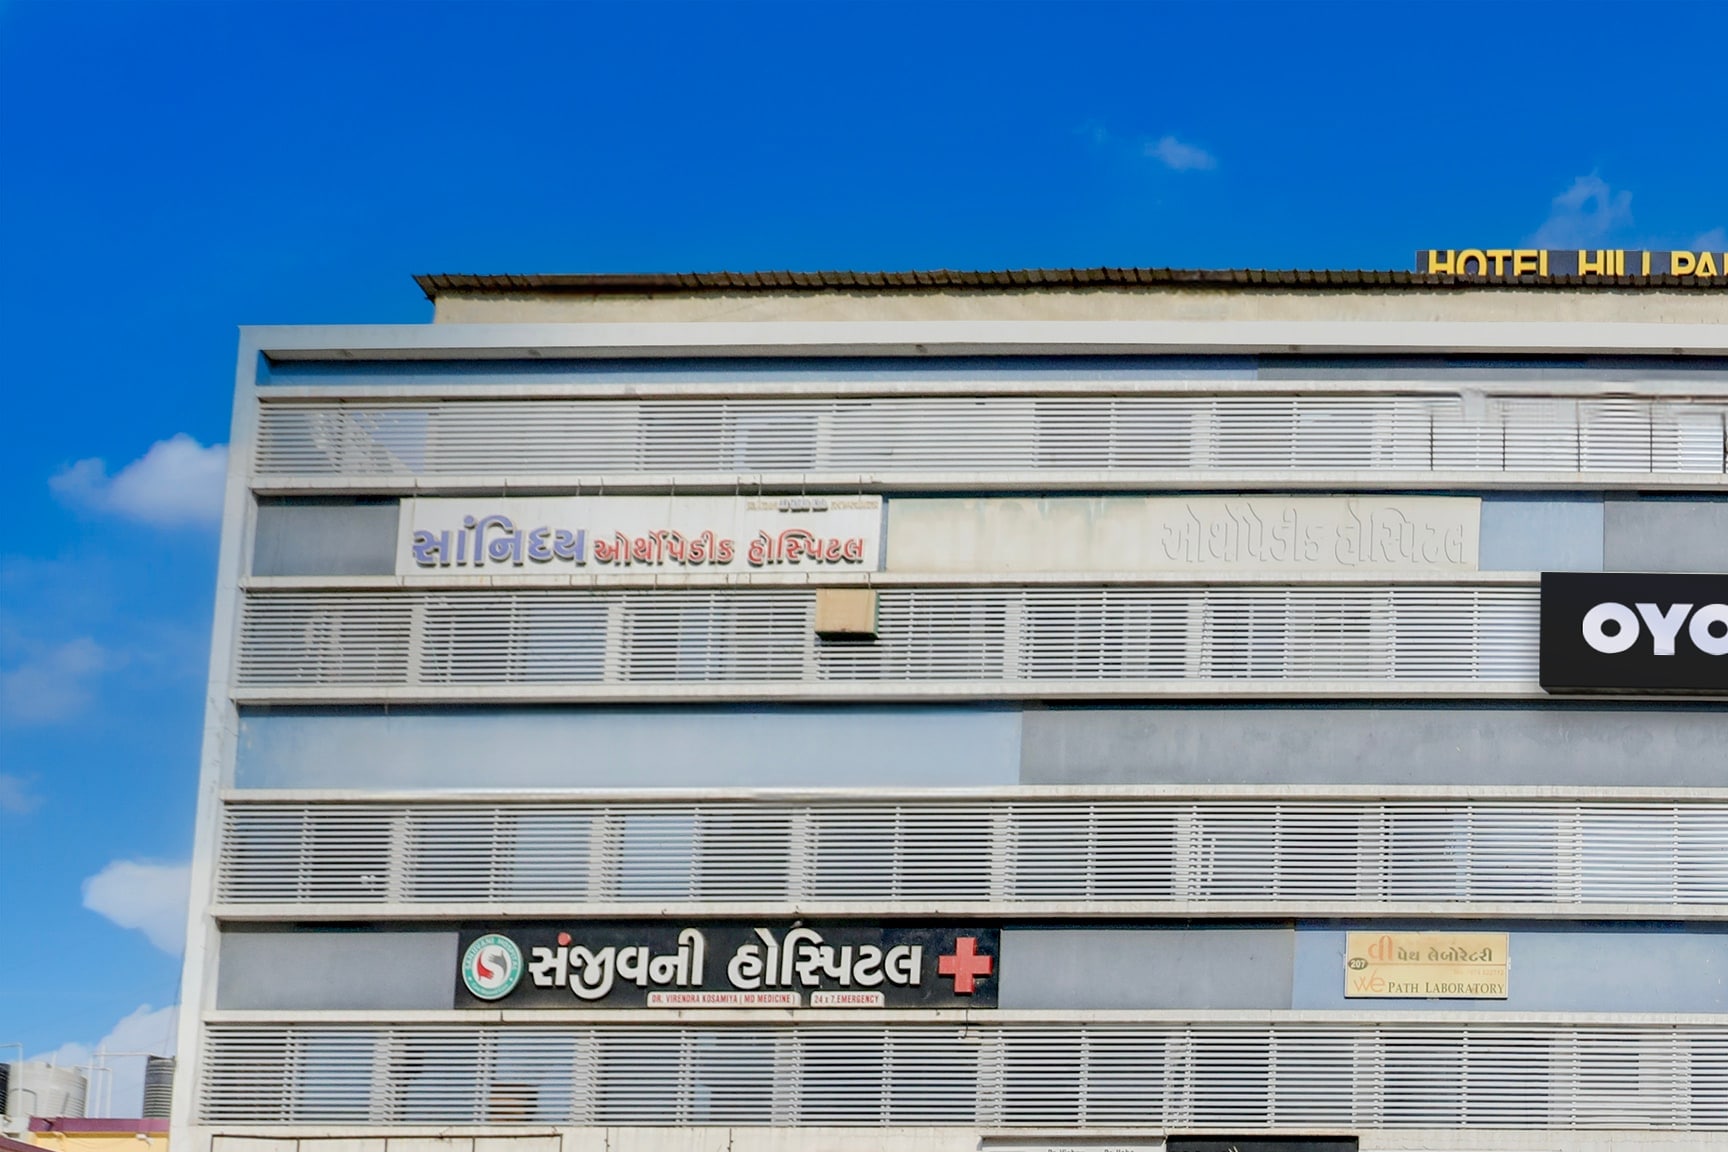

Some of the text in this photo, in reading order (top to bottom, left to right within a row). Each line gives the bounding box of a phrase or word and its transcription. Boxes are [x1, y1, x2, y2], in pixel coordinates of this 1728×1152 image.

[748, 528, 863, 564] હોસ્પિટલ
[1398, 947, 1420, 961] પેથ
[1428, 947, 1492, 962] લેબોરેટરી
[528, 927, 923, 1000] સંજીવની હોસ્પિટલ
[1351, 960, 1365, 968] 207
[1388, 982, 1505, 994] PATH LABORATORY
